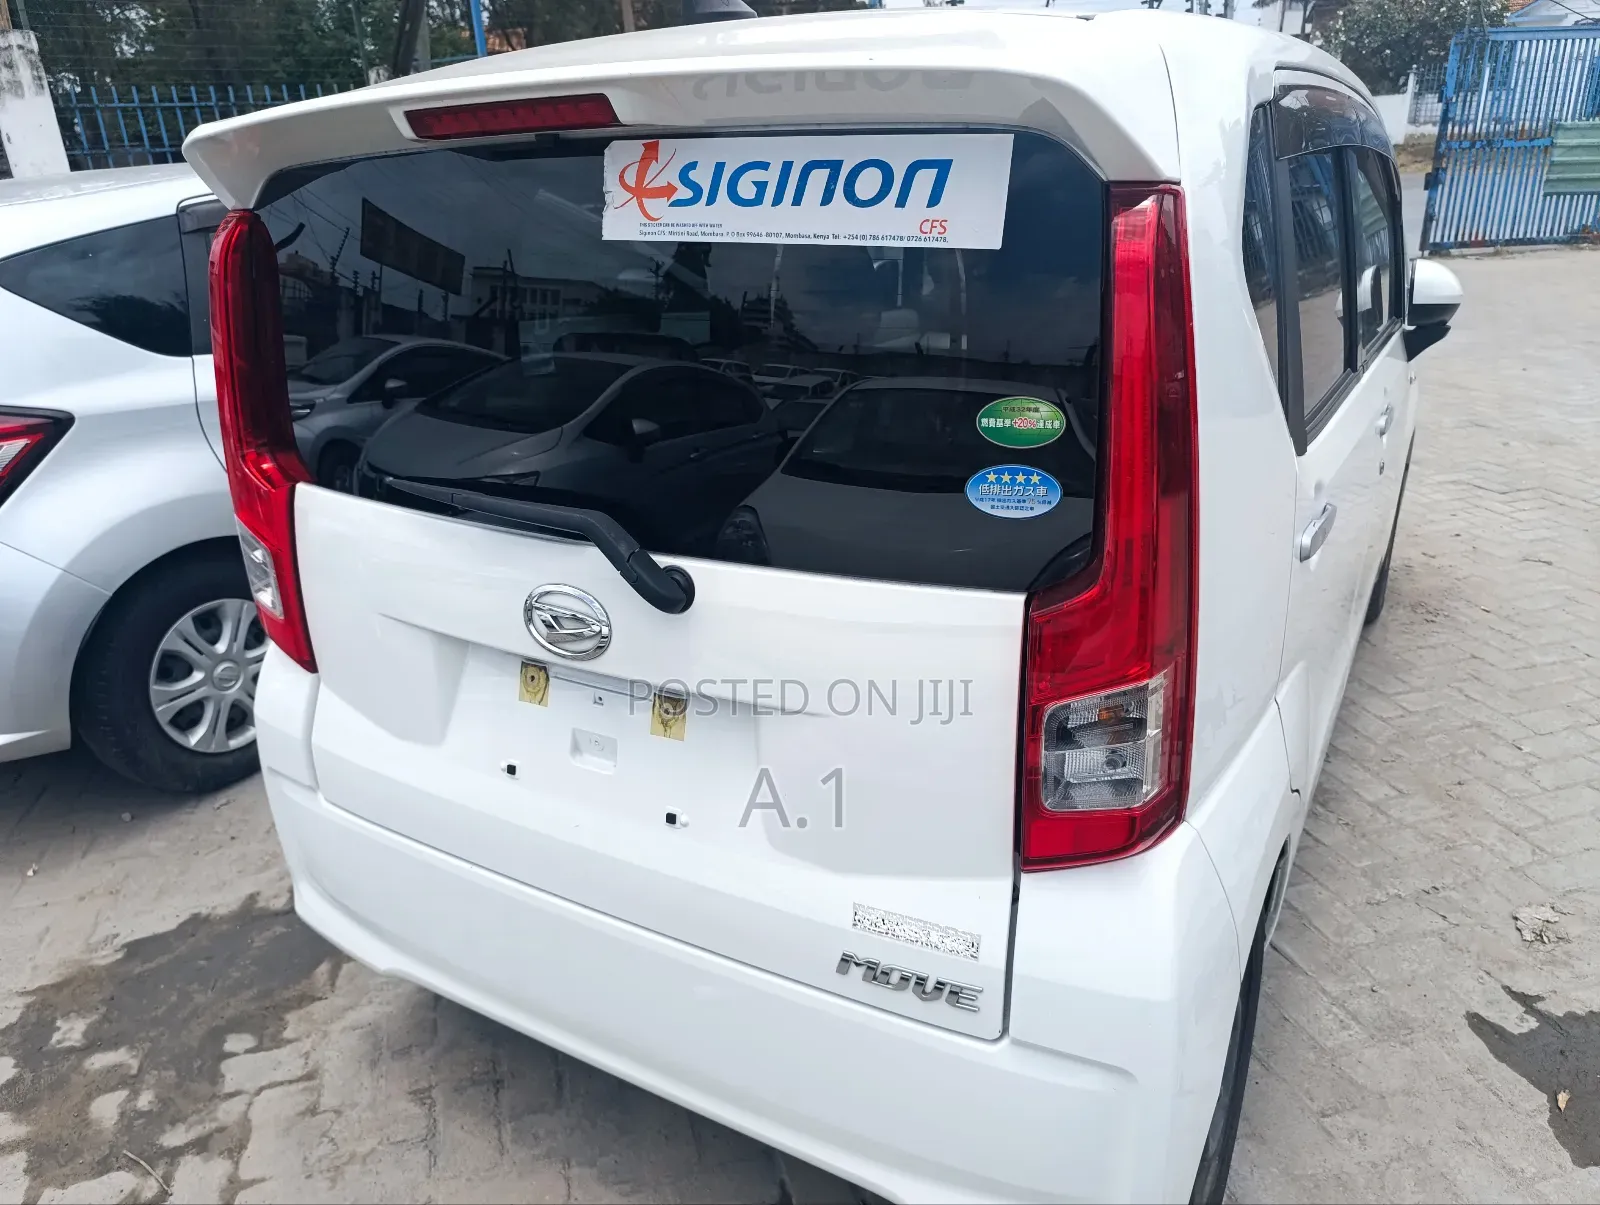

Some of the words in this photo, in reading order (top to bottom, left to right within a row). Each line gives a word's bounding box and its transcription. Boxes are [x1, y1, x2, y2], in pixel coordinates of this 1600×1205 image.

[667, 158, 954, 209] SIGINON
[919, 218, 948, 235] CFS
[979, 484, 1048, 497] 低排出ガス車
[836, 950, 983, 1012] MOVE
